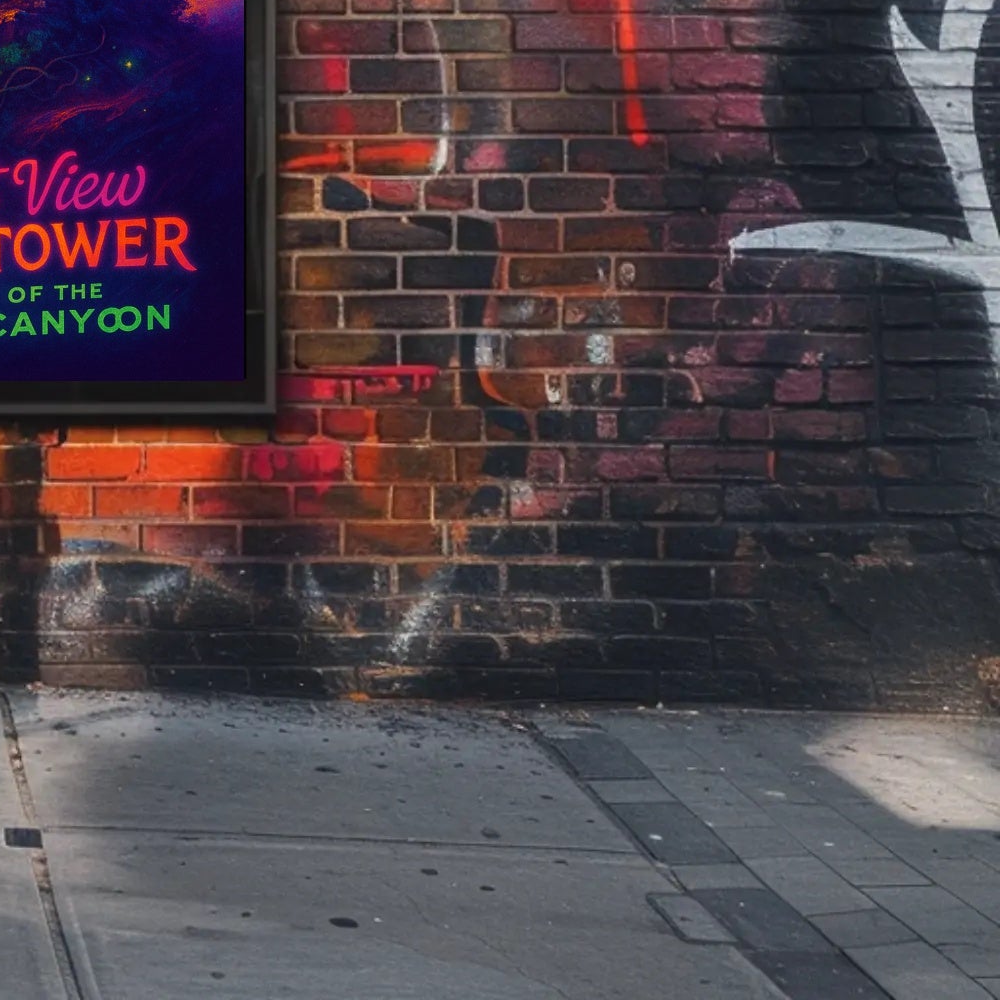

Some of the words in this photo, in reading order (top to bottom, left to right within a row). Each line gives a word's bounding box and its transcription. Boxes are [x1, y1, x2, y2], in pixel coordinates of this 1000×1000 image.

[12, 150, 147, 215] View
[8, 285, 43, 303] OF
[54, 282, 103, 300] THE
